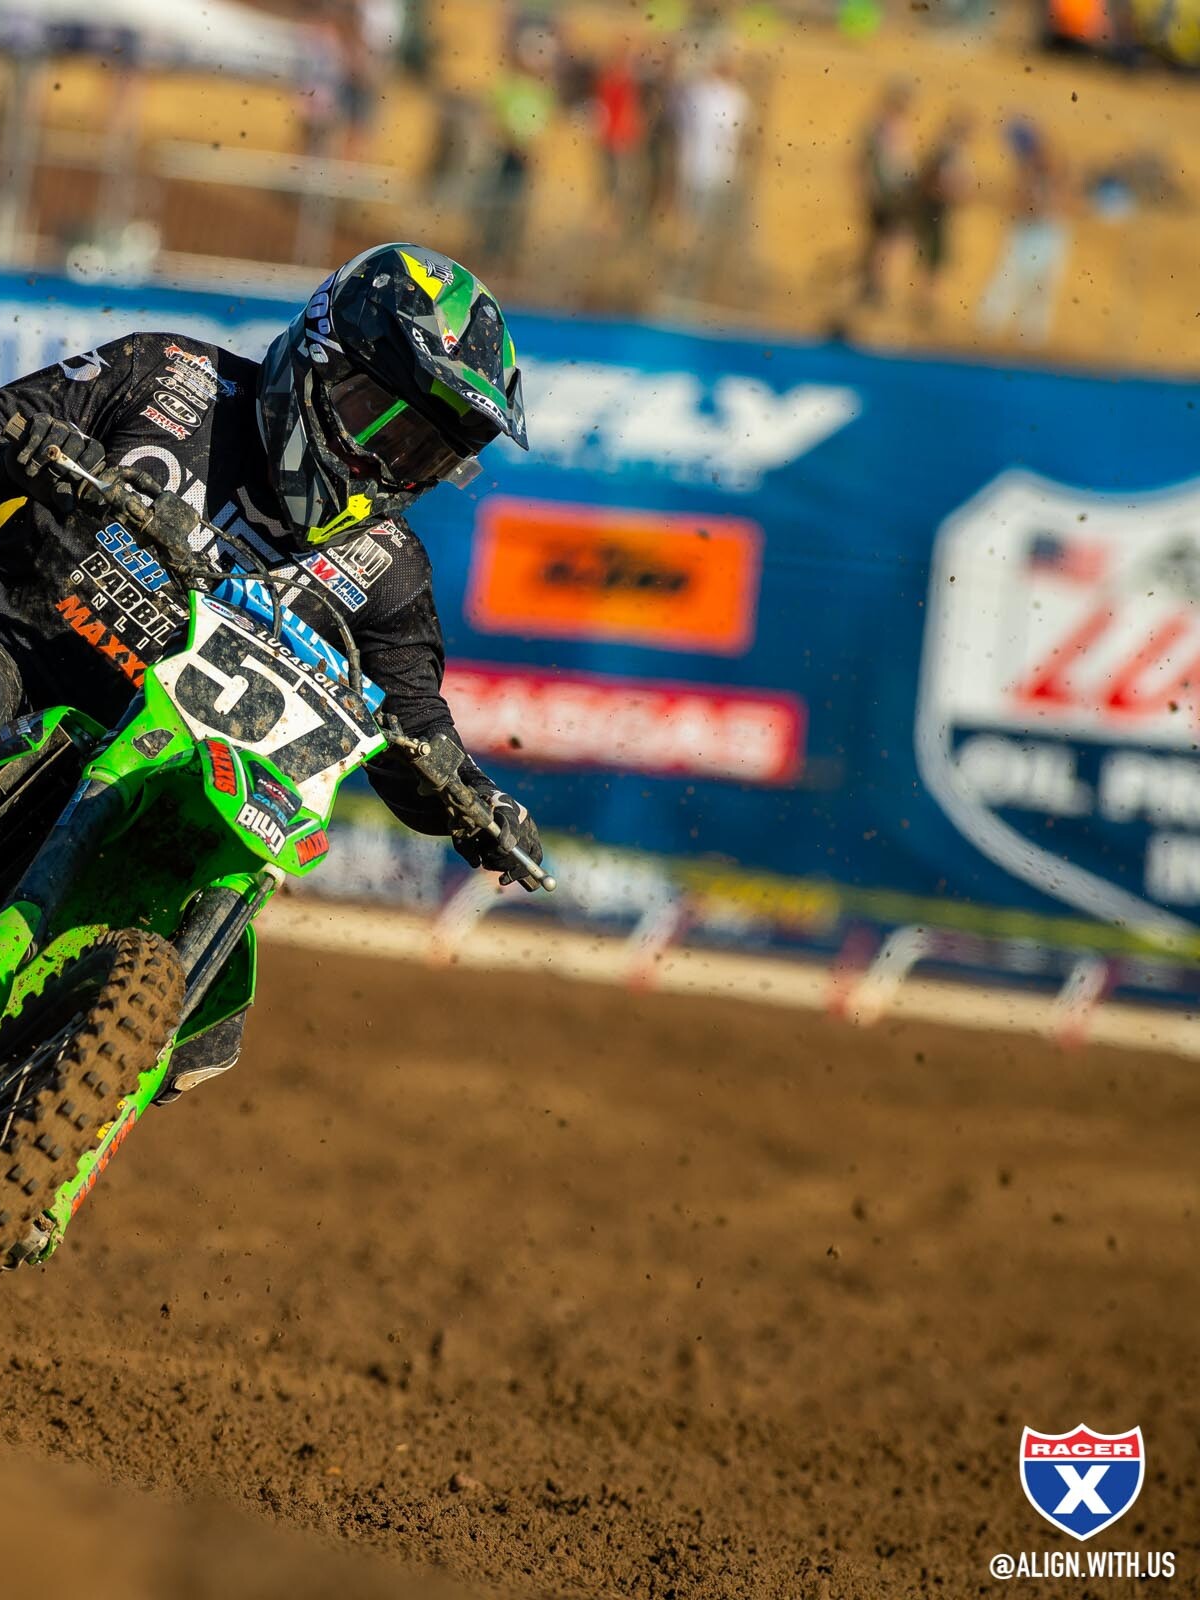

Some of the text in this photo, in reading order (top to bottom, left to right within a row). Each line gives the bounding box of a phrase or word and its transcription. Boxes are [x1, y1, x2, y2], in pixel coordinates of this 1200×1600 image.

[160, 394, 197, 421] HJC
[335, 587, 357, 610] RACING
[339, 581, 367, 606] PRO
[256, 629, 342, 697] LUCAS OIL
[174, 623, 361, 785] 57
[257, 778, 296, 812] MAYHEW
